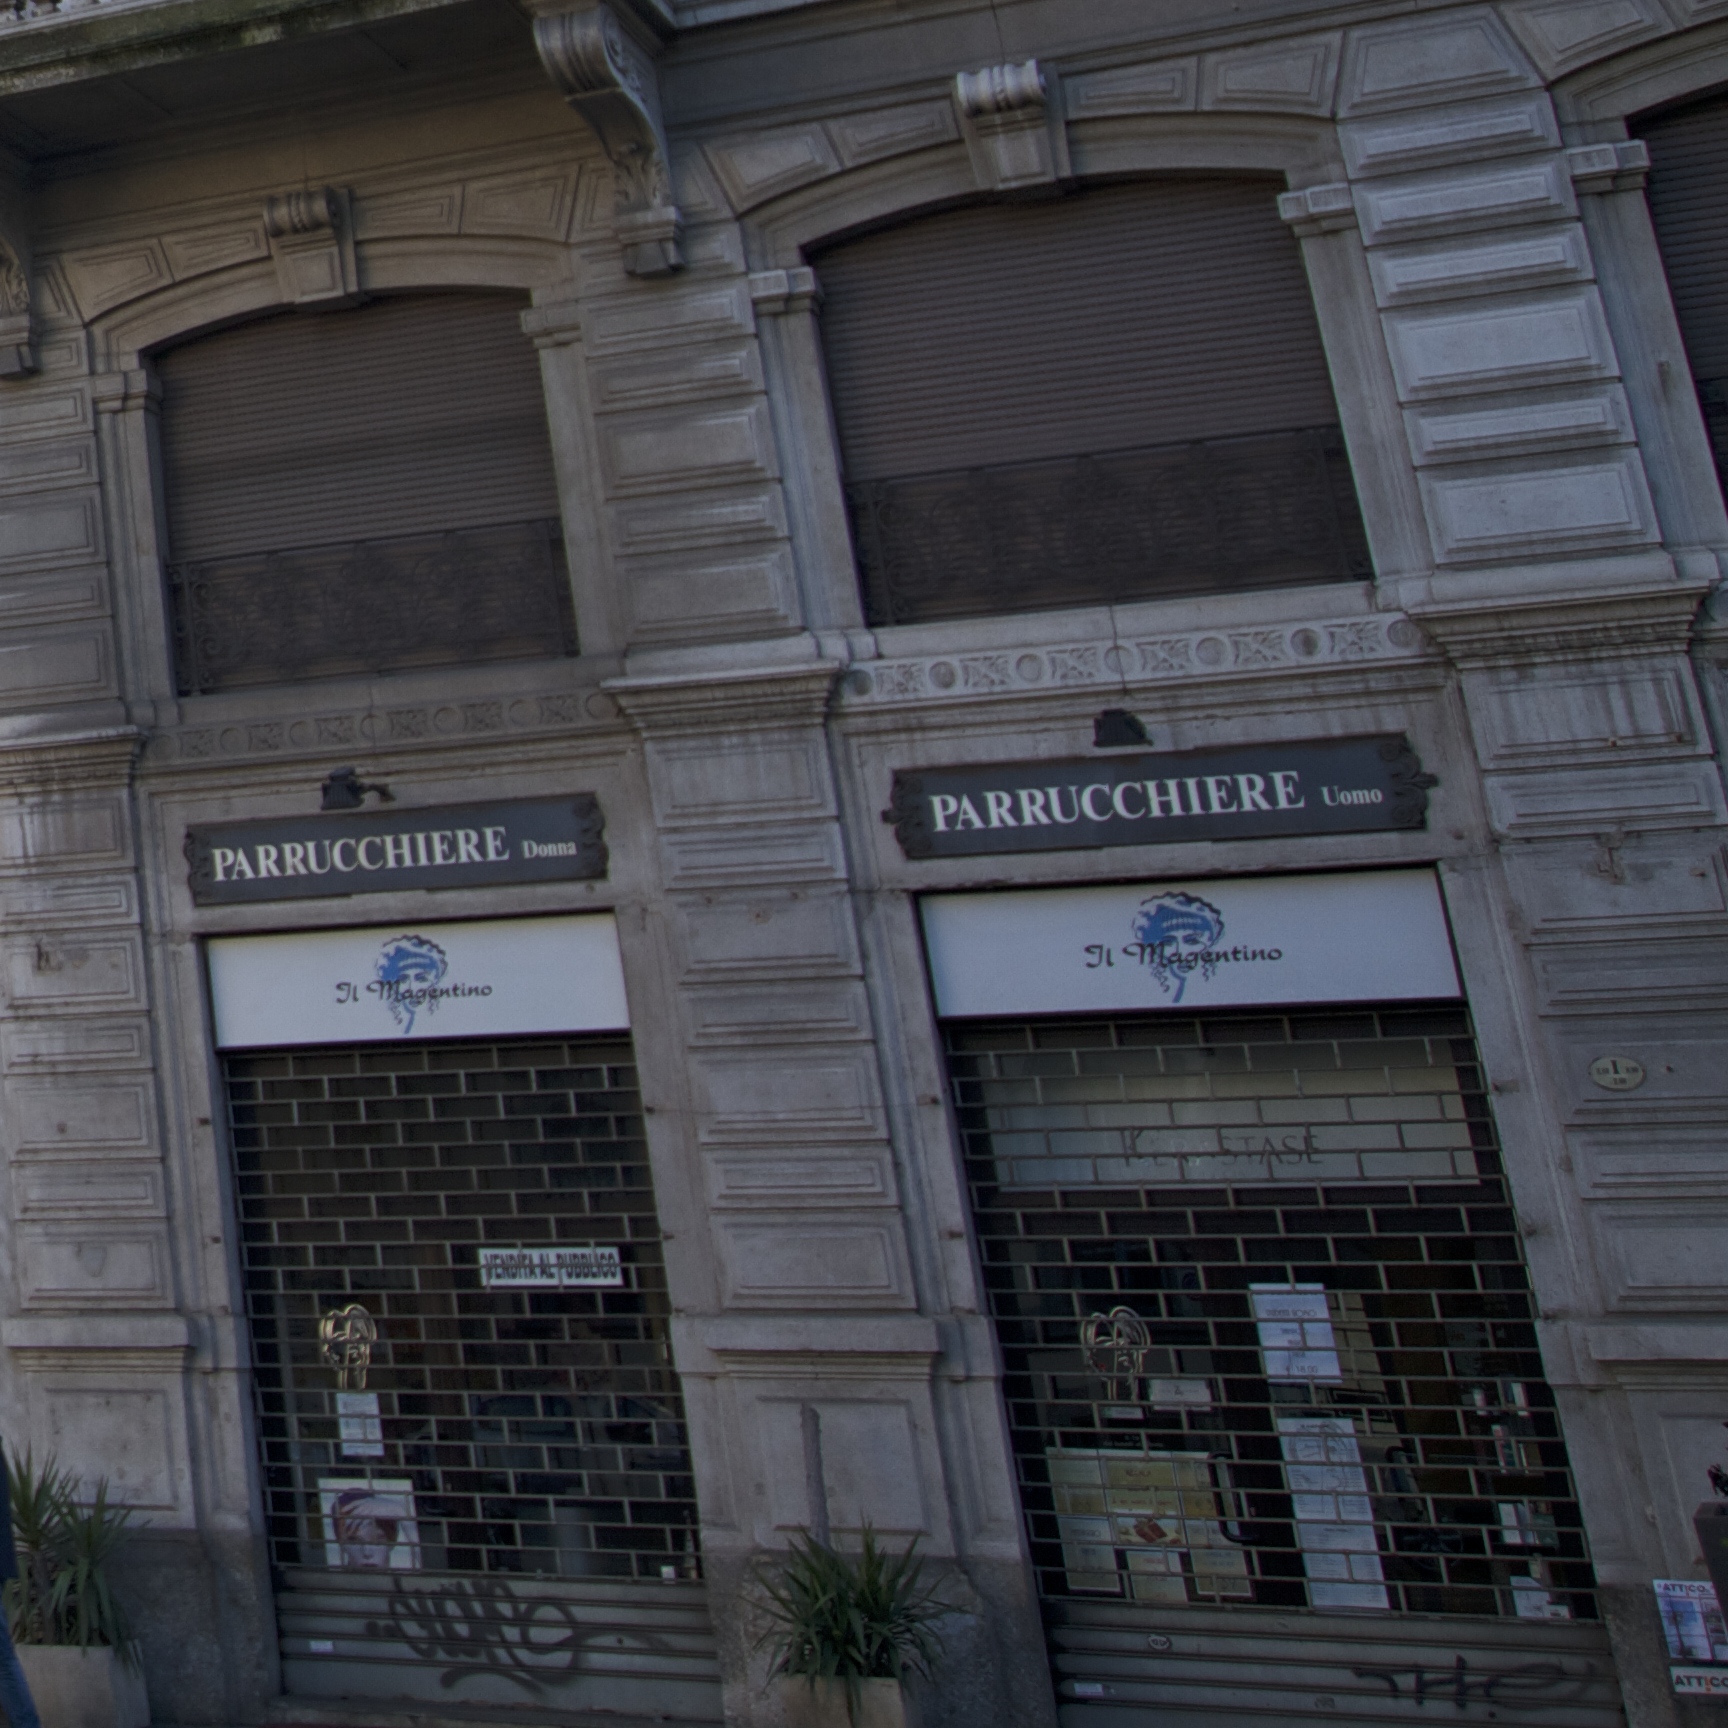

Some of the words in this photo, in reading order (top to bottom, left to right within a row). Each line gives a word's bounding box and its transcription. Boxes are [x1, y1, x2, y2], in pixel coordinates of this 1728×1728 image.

[927, 770, 1306, 833] PARRUCCHIERE
[1321, 784, 1383, 807] Uomo
[211, 825, 511, 883] PARRUCCHIERE
[521, 838, 578, 860] Donna
[1083, 943, 1115, 969] Il
[1122, 942, 1284, 971] Magentino
[335, 981, 359, 1004] Il
[365, 979, 493, 1006] Magentino
